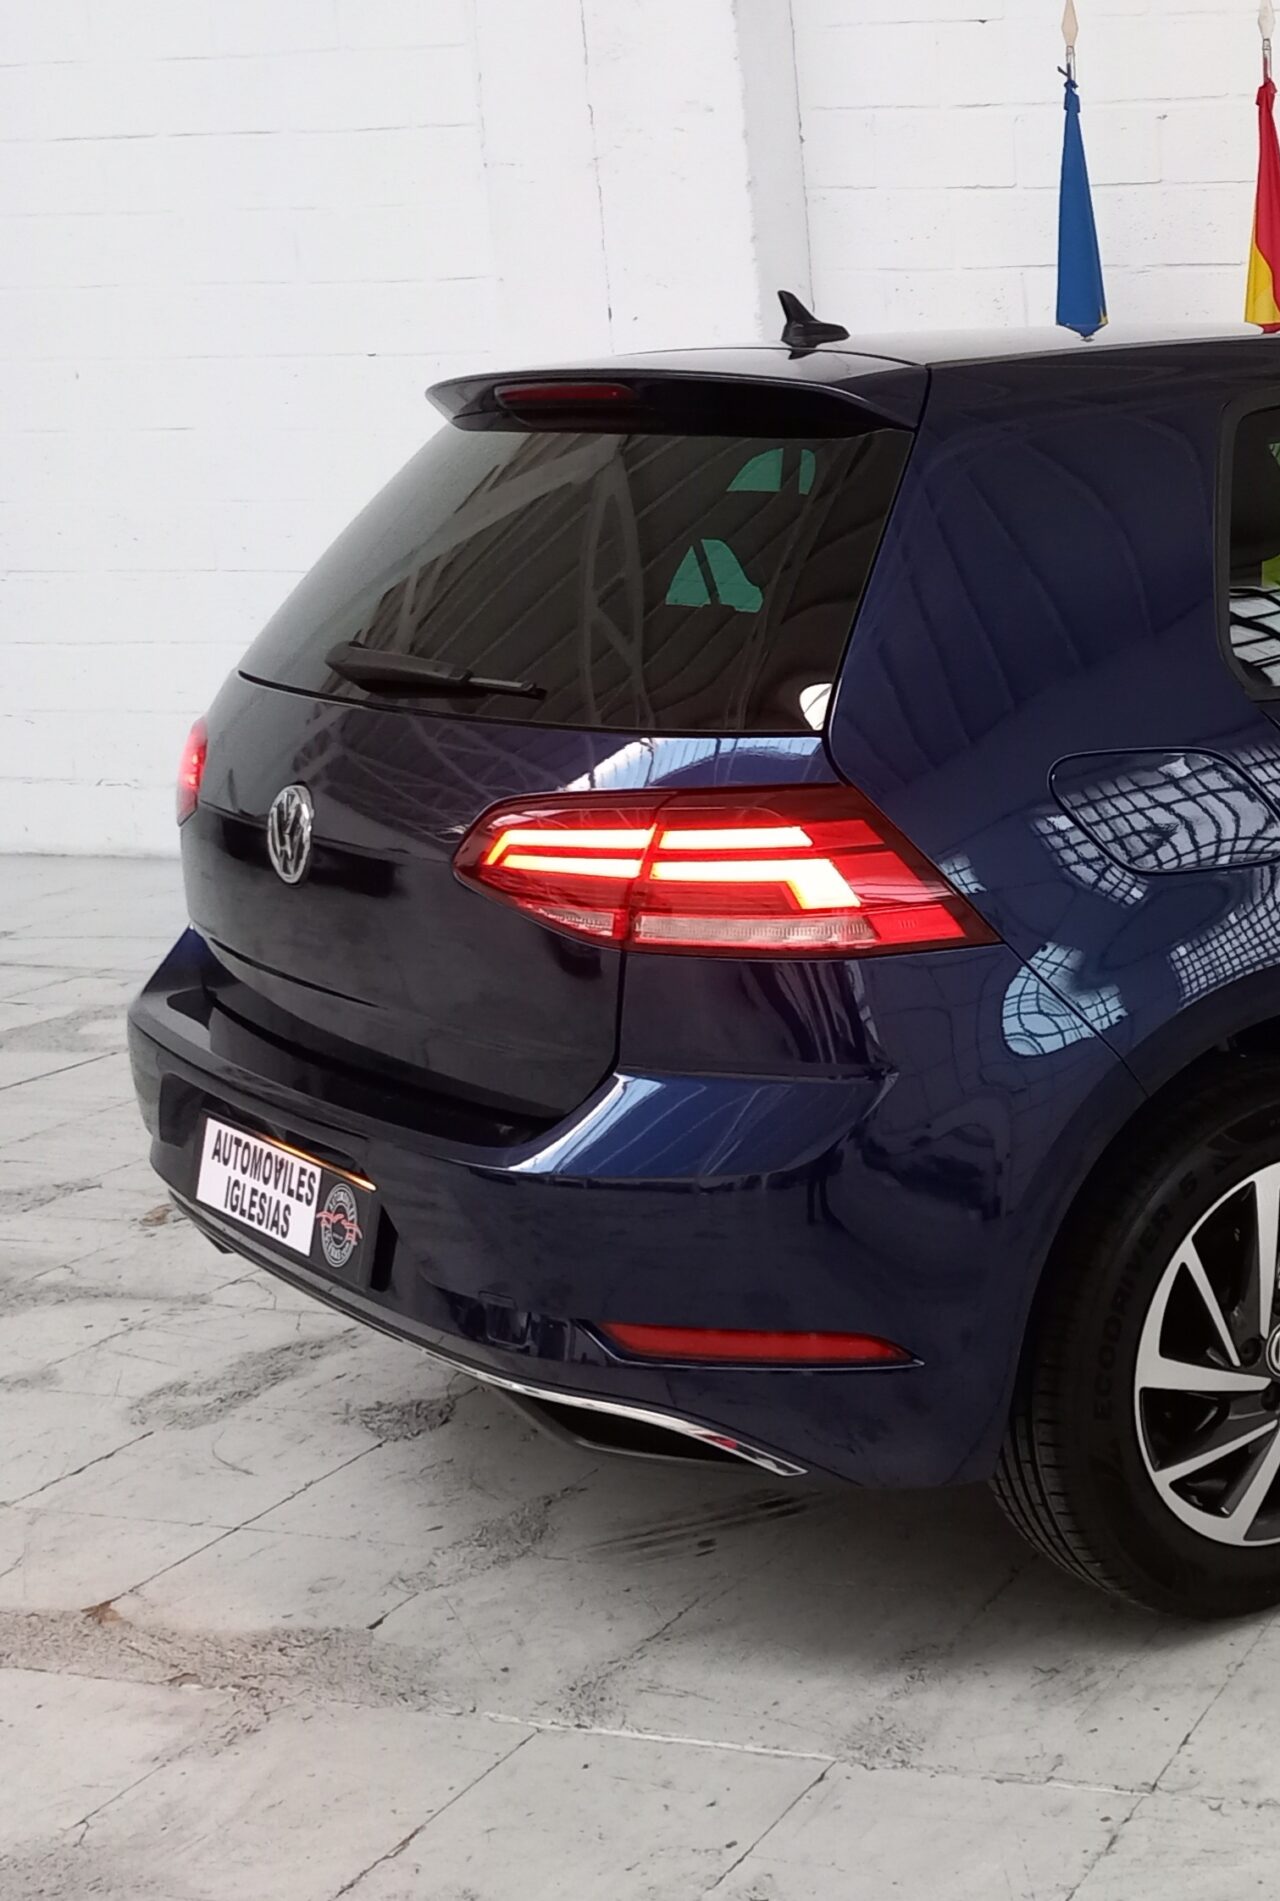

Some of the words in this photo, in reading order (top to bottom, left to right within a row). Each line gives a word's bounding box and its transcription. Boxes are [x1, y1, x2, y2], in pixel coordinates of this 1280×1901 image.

[211, 1128, 317, 1207] AUTOMOVILES
[223, 1175, 292, 1239] IGLESIAS
[1093, 1203, 1173, 1422] ECODRIVER
